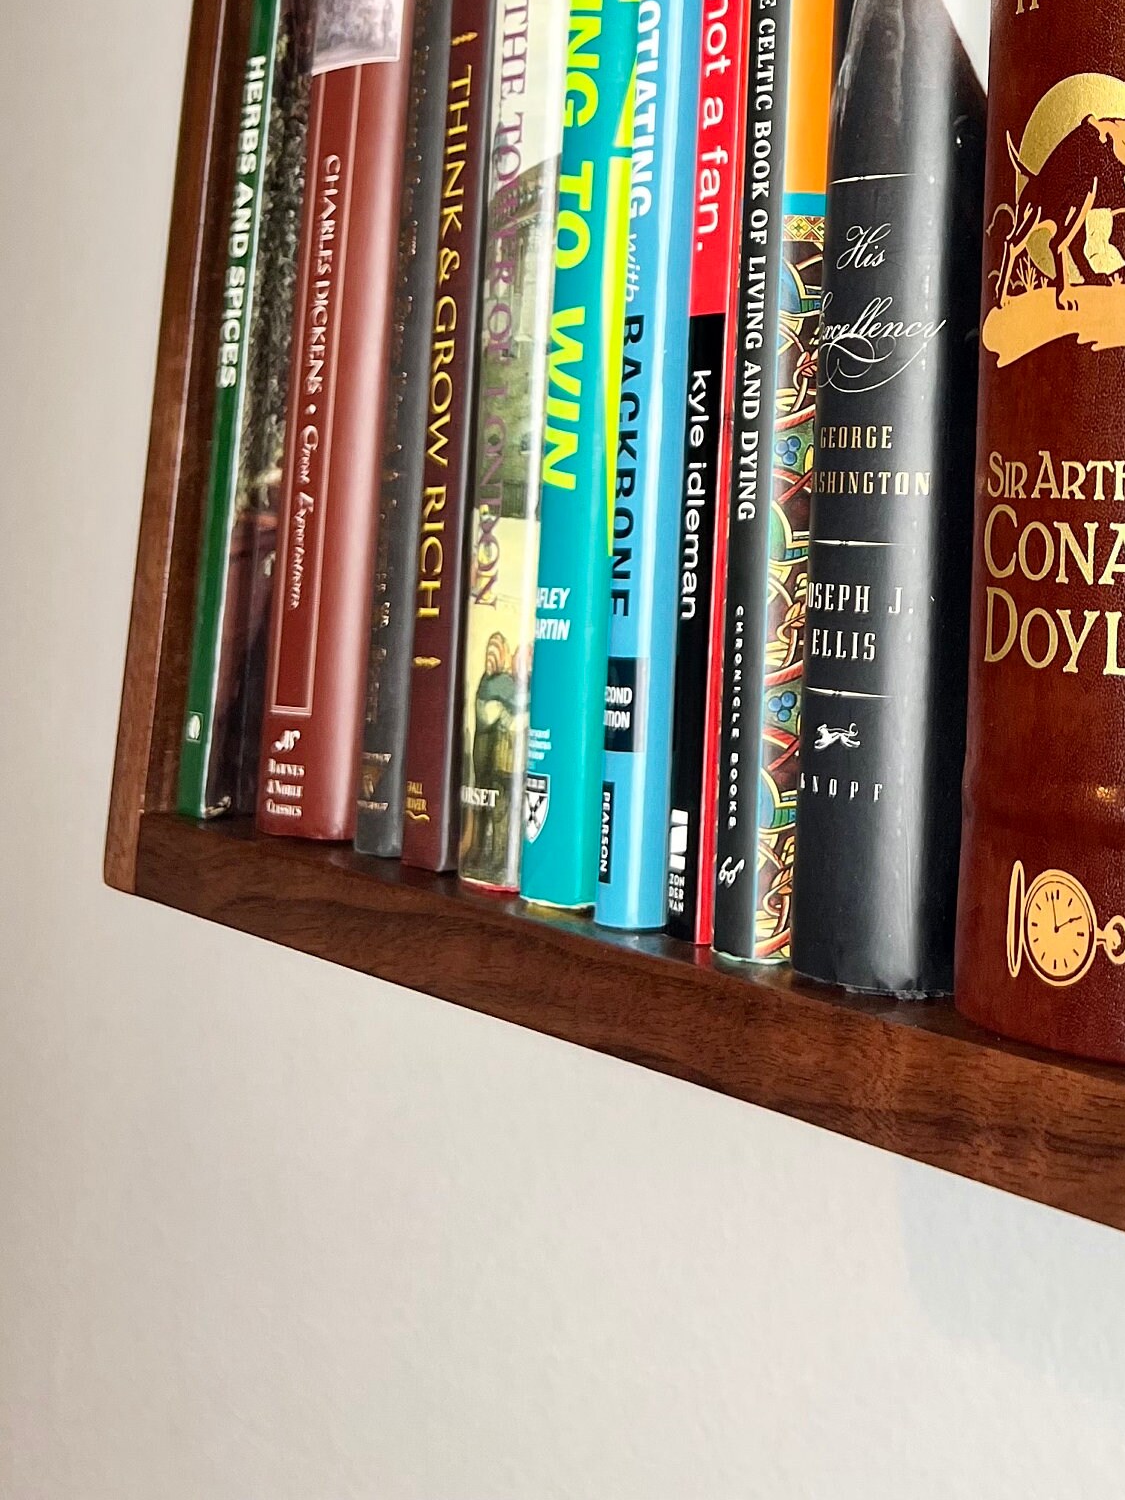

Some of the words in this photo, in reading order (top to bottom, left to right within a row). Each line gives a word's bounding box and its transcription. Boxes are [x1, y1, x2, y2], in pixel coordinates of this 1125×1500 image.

[754, 16, 778, 112] CELTIC
[236, 56, 267, 174] HERBS
[442, 64, 473, 240] THINK
[702, 96, 725, 128] a
[695, 144, 729, 253] fan.
[750, 119, 772, 202] BOOK
[227, 181, 253, 258] AND
[316, 153, 341, 276] CHARLES
[555, 162, 592, 270] TO
[749, 208, 768, 246] OF
[837, 223, 891, 270] His
[437, 247, 461, 289] &
[625, 231, 642, 302] with
[744, 255, 766, 350] LIVING
[215, 266, 245, 388] SPICES
[302, 283, 331, 397] DICKENS
[426, 296, 457, 467] GROW
[543, 306, 586, 490] WIN
[690, 368, 712, 448] kyle
[741, 360, 761, 421] AND
[611, 314, 644, 618] BACKBONE
[737, 430, 759, 522] DYING
[820, 426, 893, 449] GEORGE
[985, 451, 1029, 497] SIR
[416, 485, 447, 618] RICH
[680, 461, 707, 620] idleman
[807, 582, 871, 613] OSEPH
[888, 587, 914, 615] J.
[730, 605, 744, 738] CHRONICLE
[811, 628, 876, 661] ELLIS
[461, 785, 500, 808] ORSET
[600, 790, 611, 874] PEARSON
[727, 752, 740, 830] BOOKS
[668, 873, 685, 887] ZON
[668, 886, 684, 900] DER
[668, 900, 684, 912] VAN
